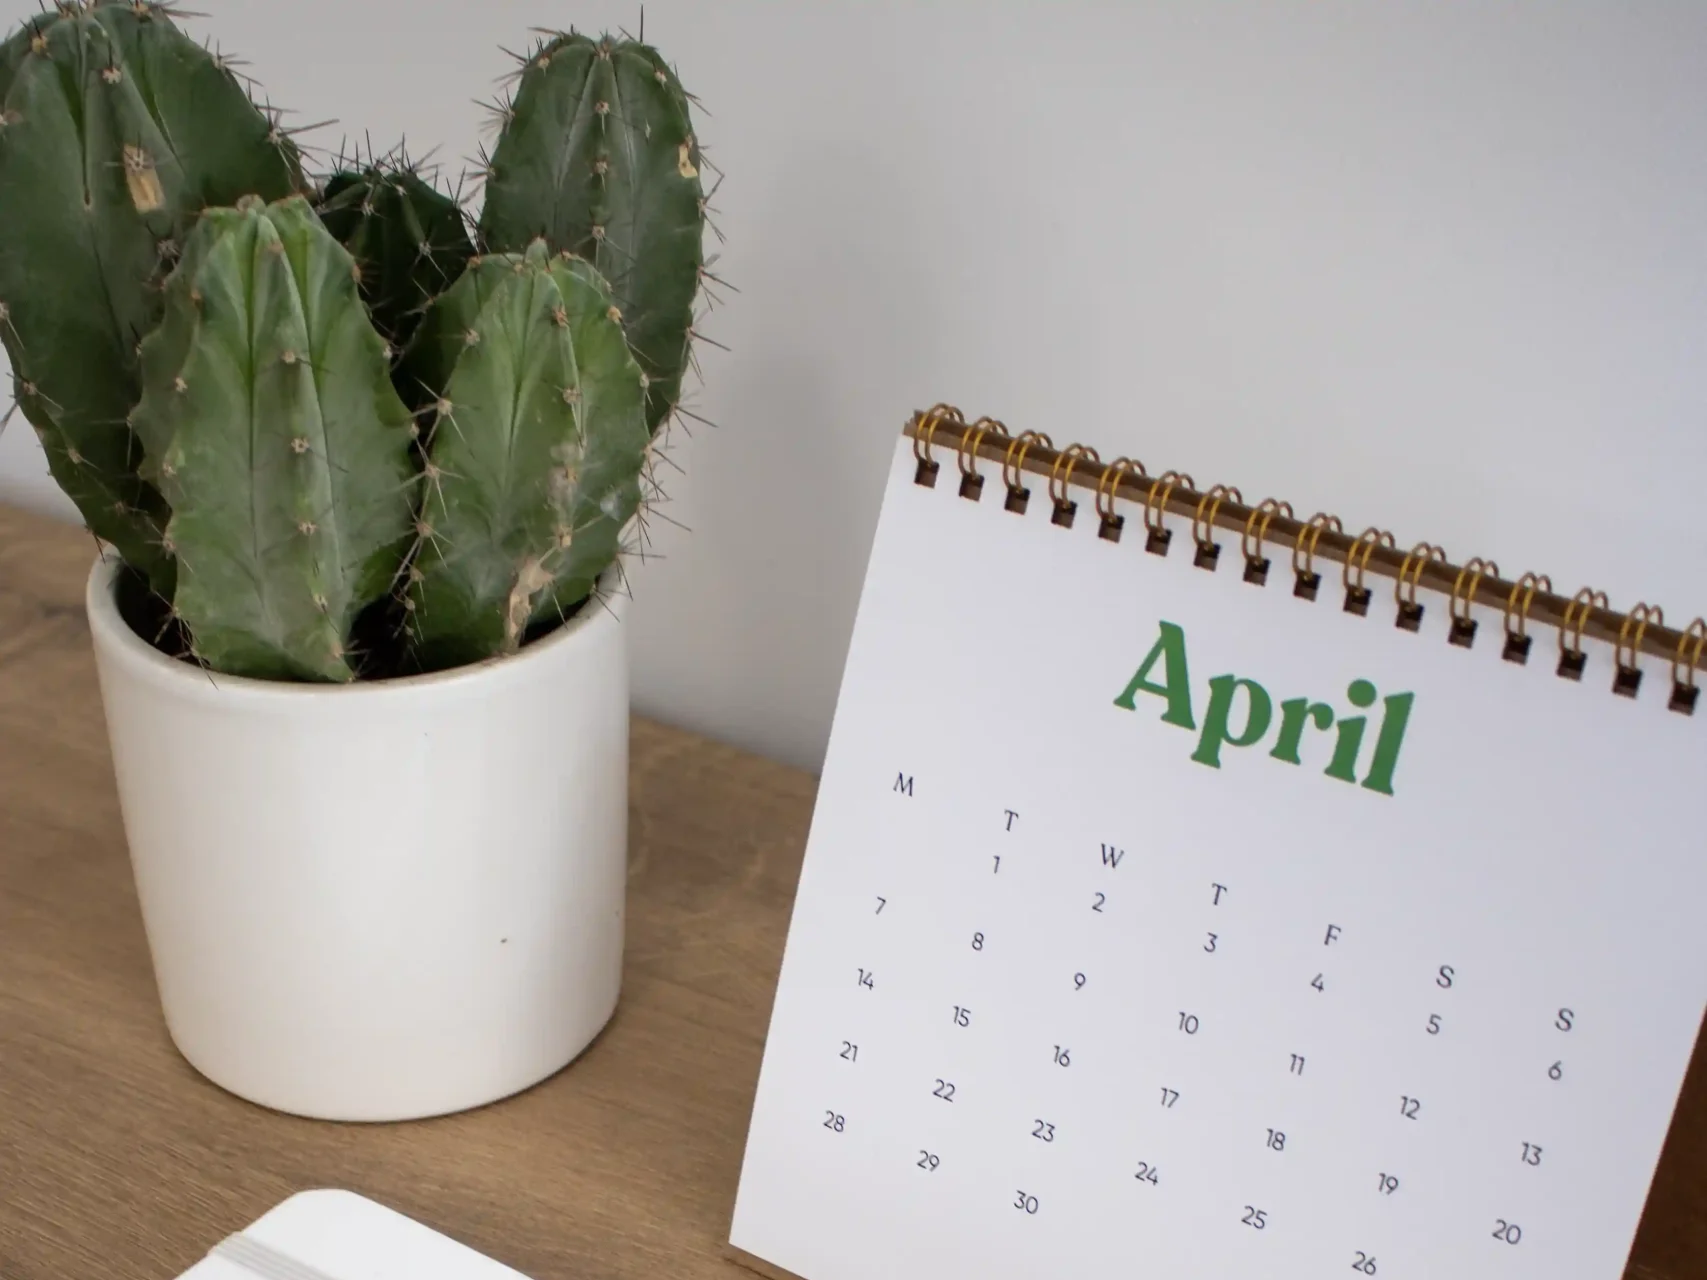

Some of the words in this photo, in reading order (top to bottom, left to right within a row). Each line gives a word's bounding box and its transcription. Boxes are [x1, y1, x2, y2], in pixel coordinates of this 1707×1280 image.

[1113, 621, 1416, 797] April
[892, 771, 914, 798] M
[1003, 809, 1020, 833] T
[1100, 842, 1125, 870] W
[1211, 882, 1228, 907] T
[1323, 923, 1342, 947] F
[1435, 964, 1455, 989] S
[1554, 1007, 1575, 1033] S
[991, 854, 1001, 875] 1
[1091, 891, 1106, 914] 2
[1203, 931, 1219, 954] 3
[1310, 972, 1325, 994] 4
[1425, 1013, 1443, 1036] 5
[1547, 1059, 1563, 1081] 6
[857, 967, 875, 991] 14
[952, 1005, 972, 1028] 15
[1053, 1044, 1071, 1068] 16
[1160, 1086, 1180, 1109] 17
[1266, 1127, 1286, 1152] 18
[1378, 1172, 1400, 1196] 19
[1491, 1218, 1522, 1246] 20
[875, 895, 887, 916] 7
[971, 931, 985, 952] 8
[1073, 971, 1087, 992] 9
[1178, 1011, 1200, 1036] 10
[1289, 1053, 1306, 1077] 11
[1400, 1095, 1421, 1121] 12
[1521, 1141, 1544, 1167] 13
[822, 1109, 846, 1133] 28
[916, 1149, 941, 1173] 29
[1013, 1189, 1039, 1215] 30
[839, 1040, 859, 1063] 21
[931, 1078, 956, 1104] 22
[1031, 1118, 1056, 1143] 23
[1134, 1160, 1159, 1187] 24
[1240, 1205, 1268, 1230] 25
[1351, 1250, 1377, 1277] 26
